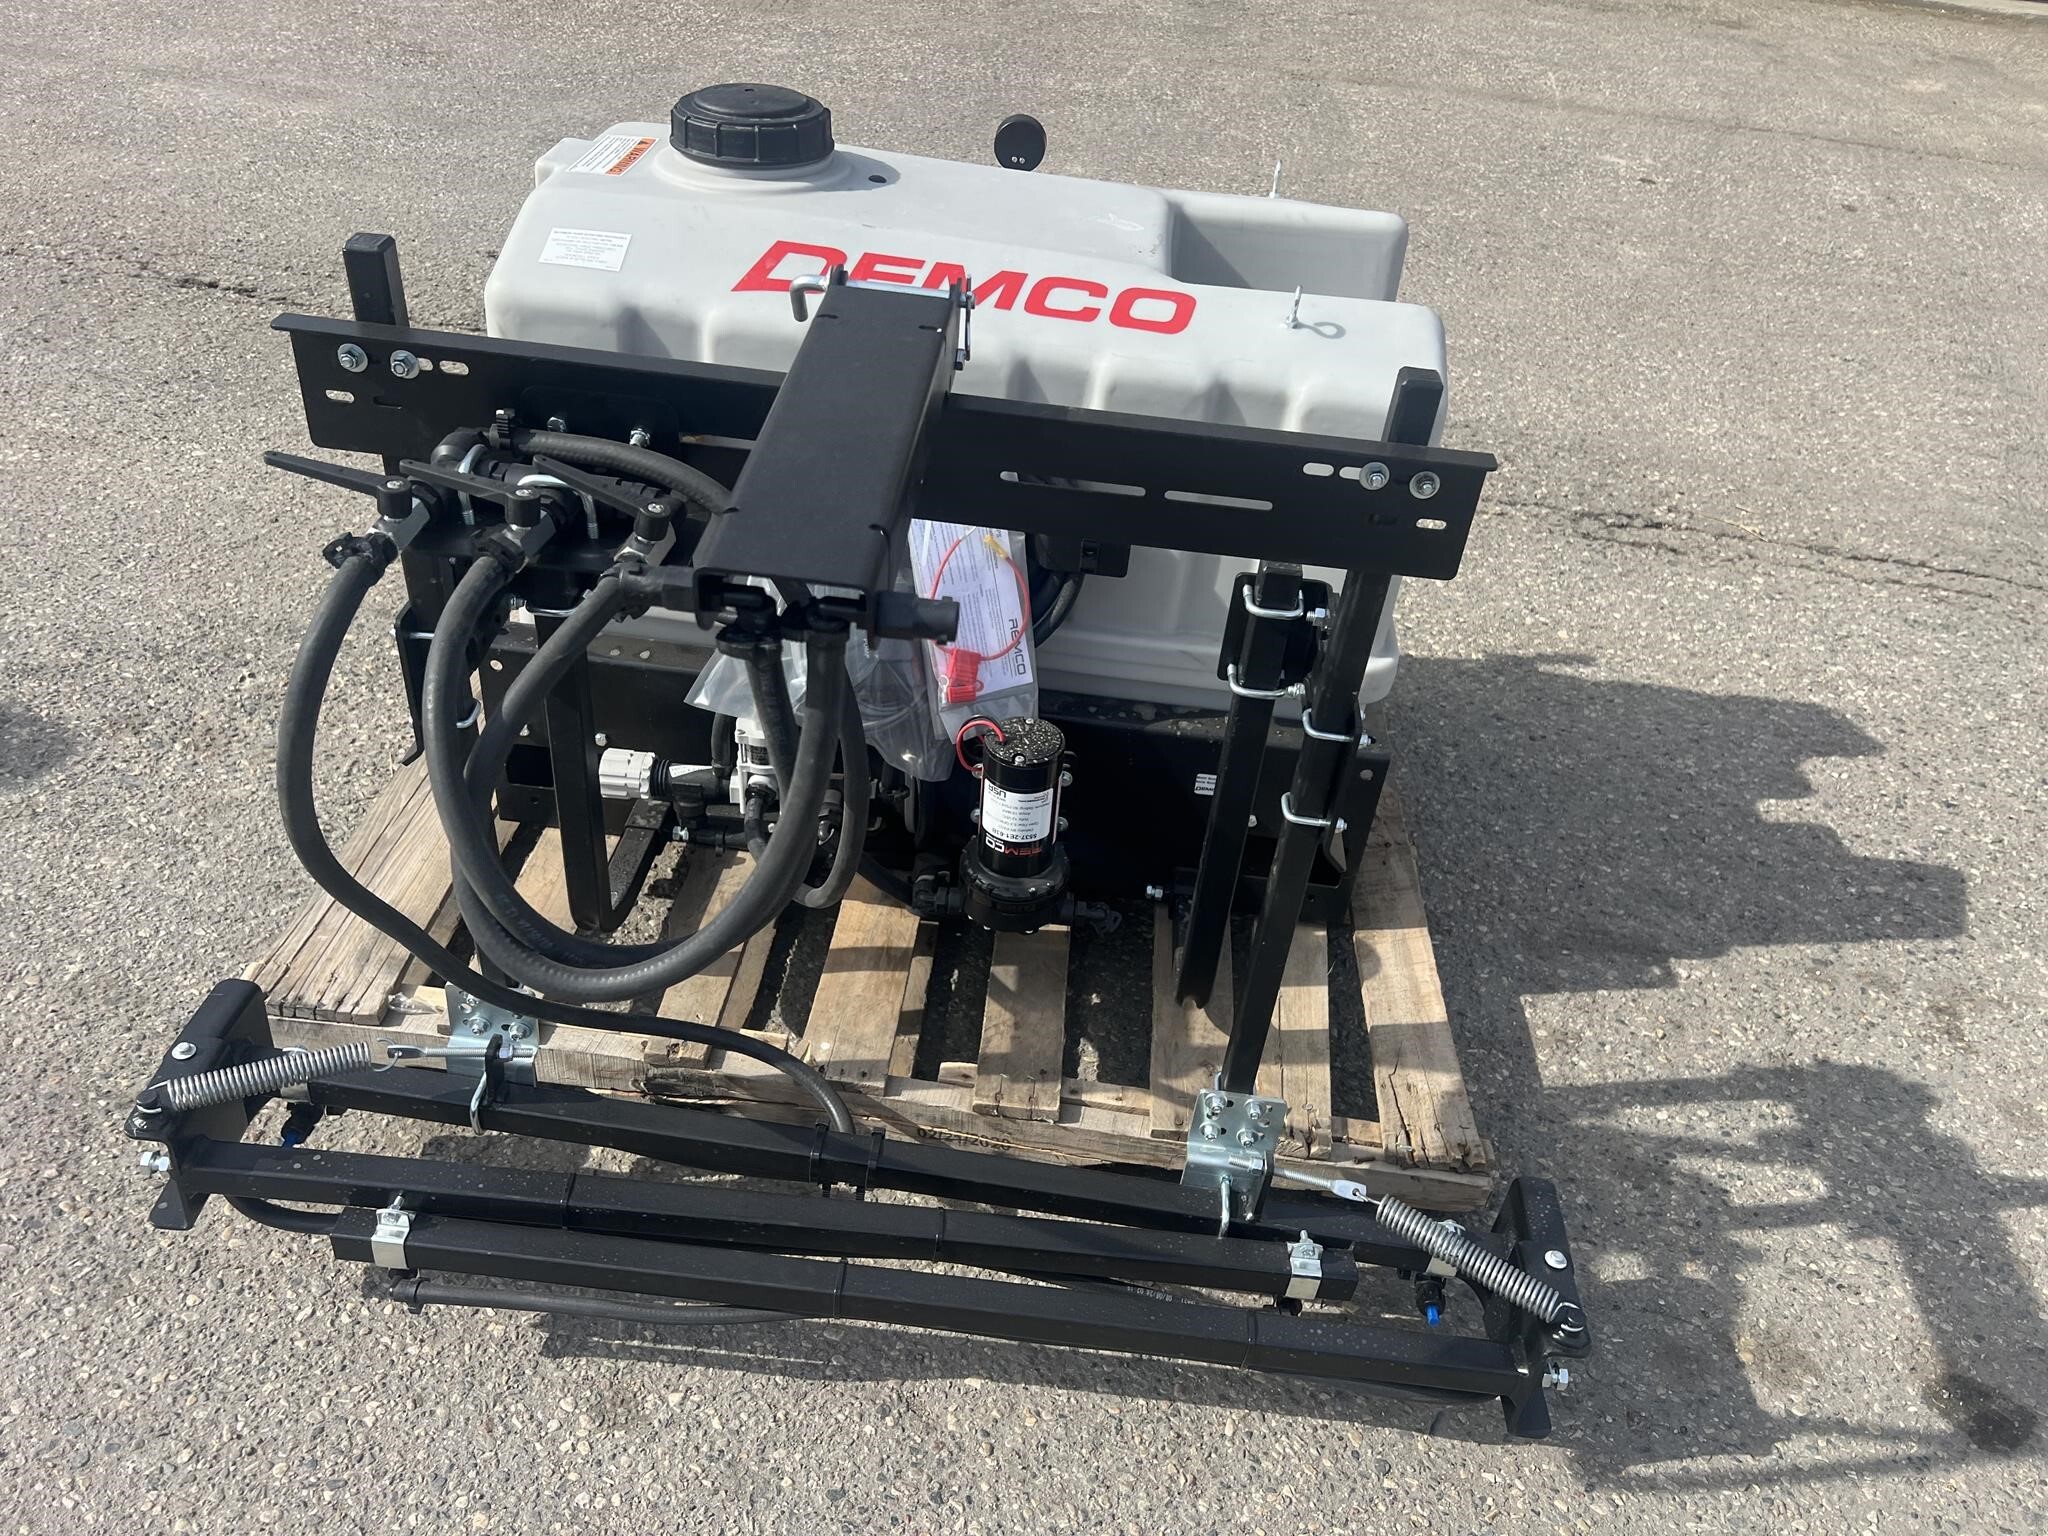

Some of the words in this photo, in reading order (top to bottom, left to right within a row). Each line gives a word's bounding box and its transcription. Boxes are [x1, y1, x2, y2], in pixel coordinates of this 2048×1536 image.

[607, 146, 646, 174] WARNING
[731, 240, 1197, 335] DEMCO
[1009, 618, 1026, 675] REMCO
[988, 783, 1006, 799] USA
